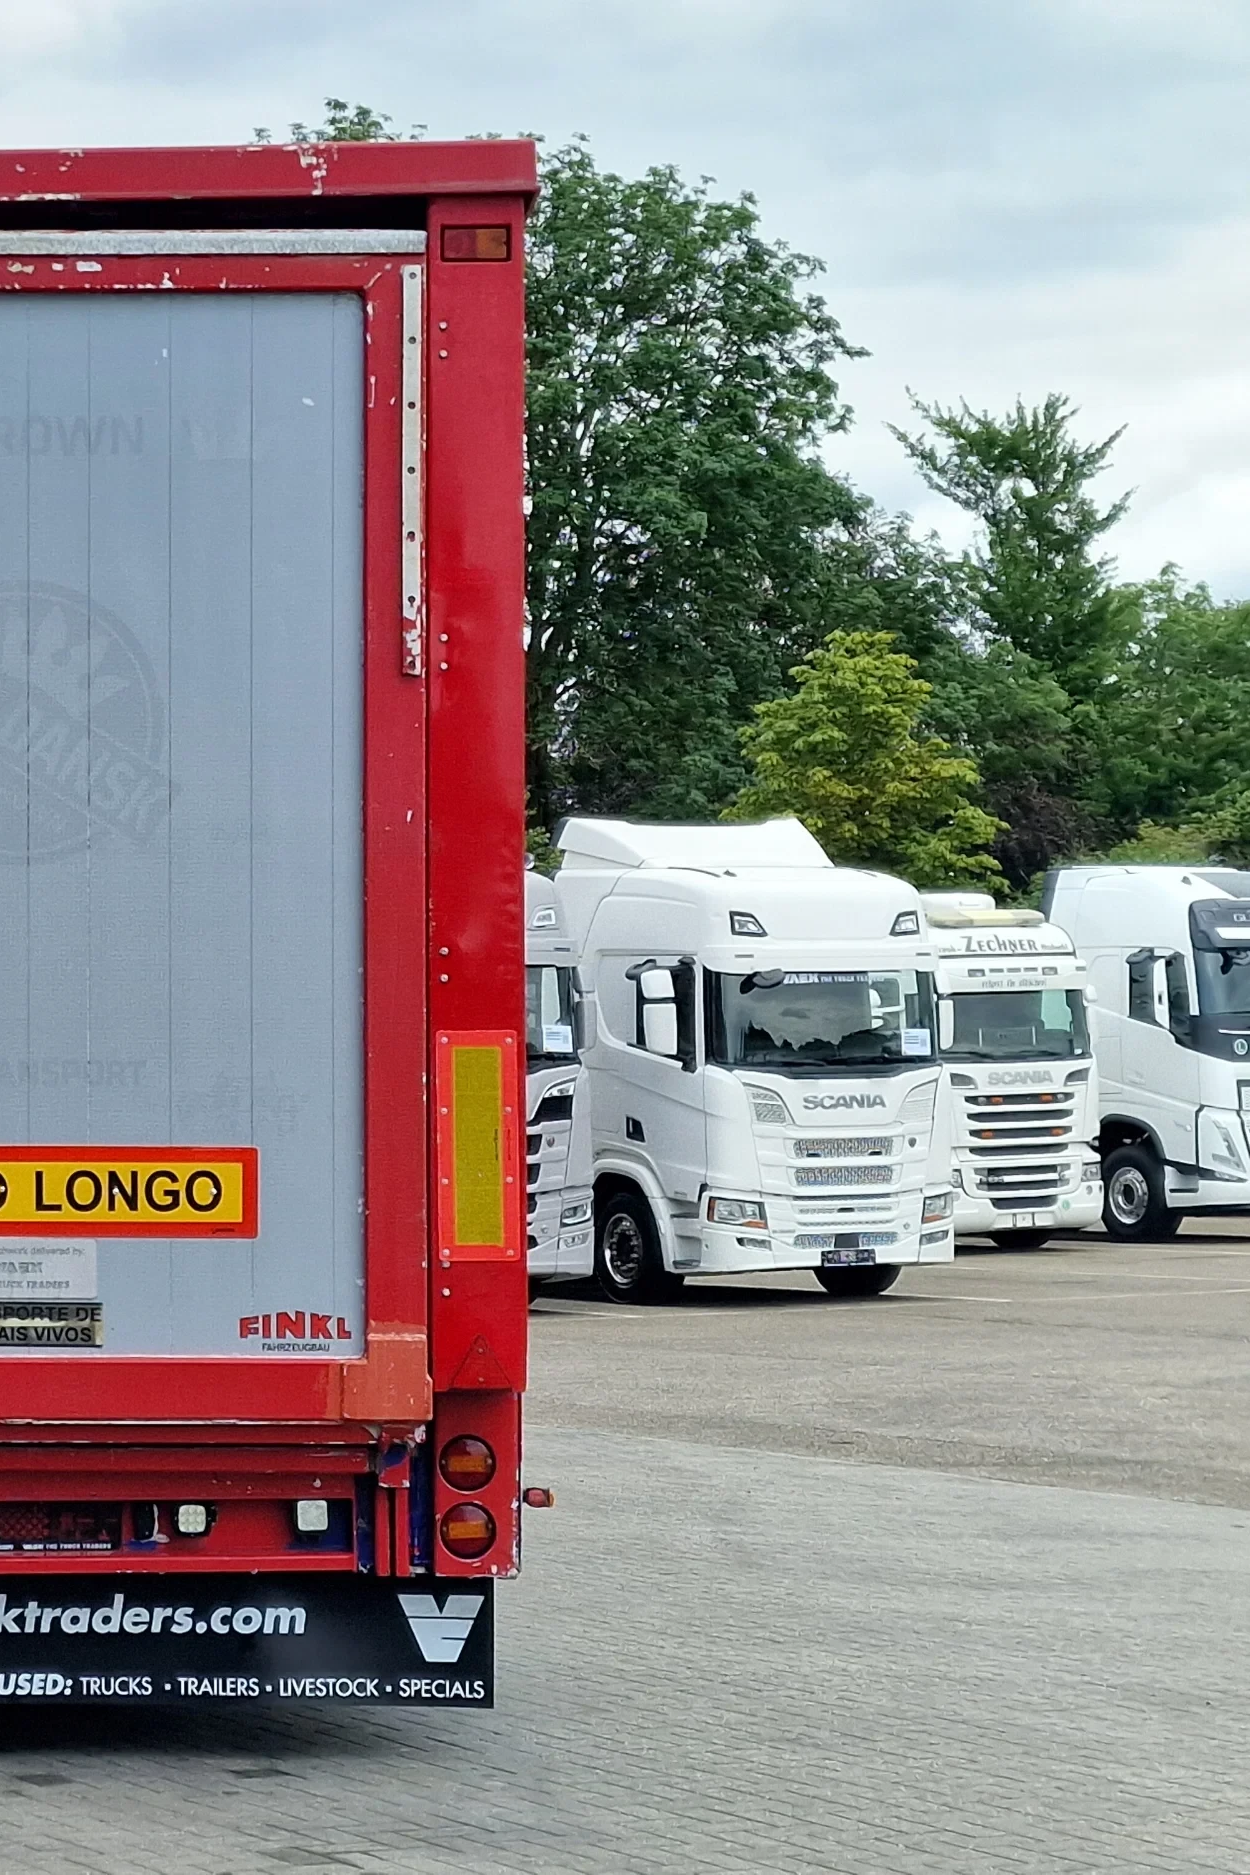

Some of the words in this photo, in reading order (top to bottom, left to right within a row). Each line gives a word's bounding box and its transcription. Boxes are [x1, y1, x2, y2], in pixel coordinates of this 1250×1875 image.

[986, 1070, 1054, 1086] SCANIA
[803, 1093, 887, 1110] SCANIA
[35, 1170, 223, 1212] LONGO
[26, 1280, 70, 1289] TRADERS
[75, 1306, 102, 1322] DE
[239, 1310, 352, 1340] FINKL
[34, 1326, 92, 1342] VIVOS
[262, 1343, 330, 1352] FAHRZEUGBAU
[79, 1676, 152, 1697] TRUCKS
[177, 1677, 260, 1698] TRAILERS
[279, 1677, 379, 1698] LIVESTOCK
[399, 1678, 485, 1700] SPECIALS
